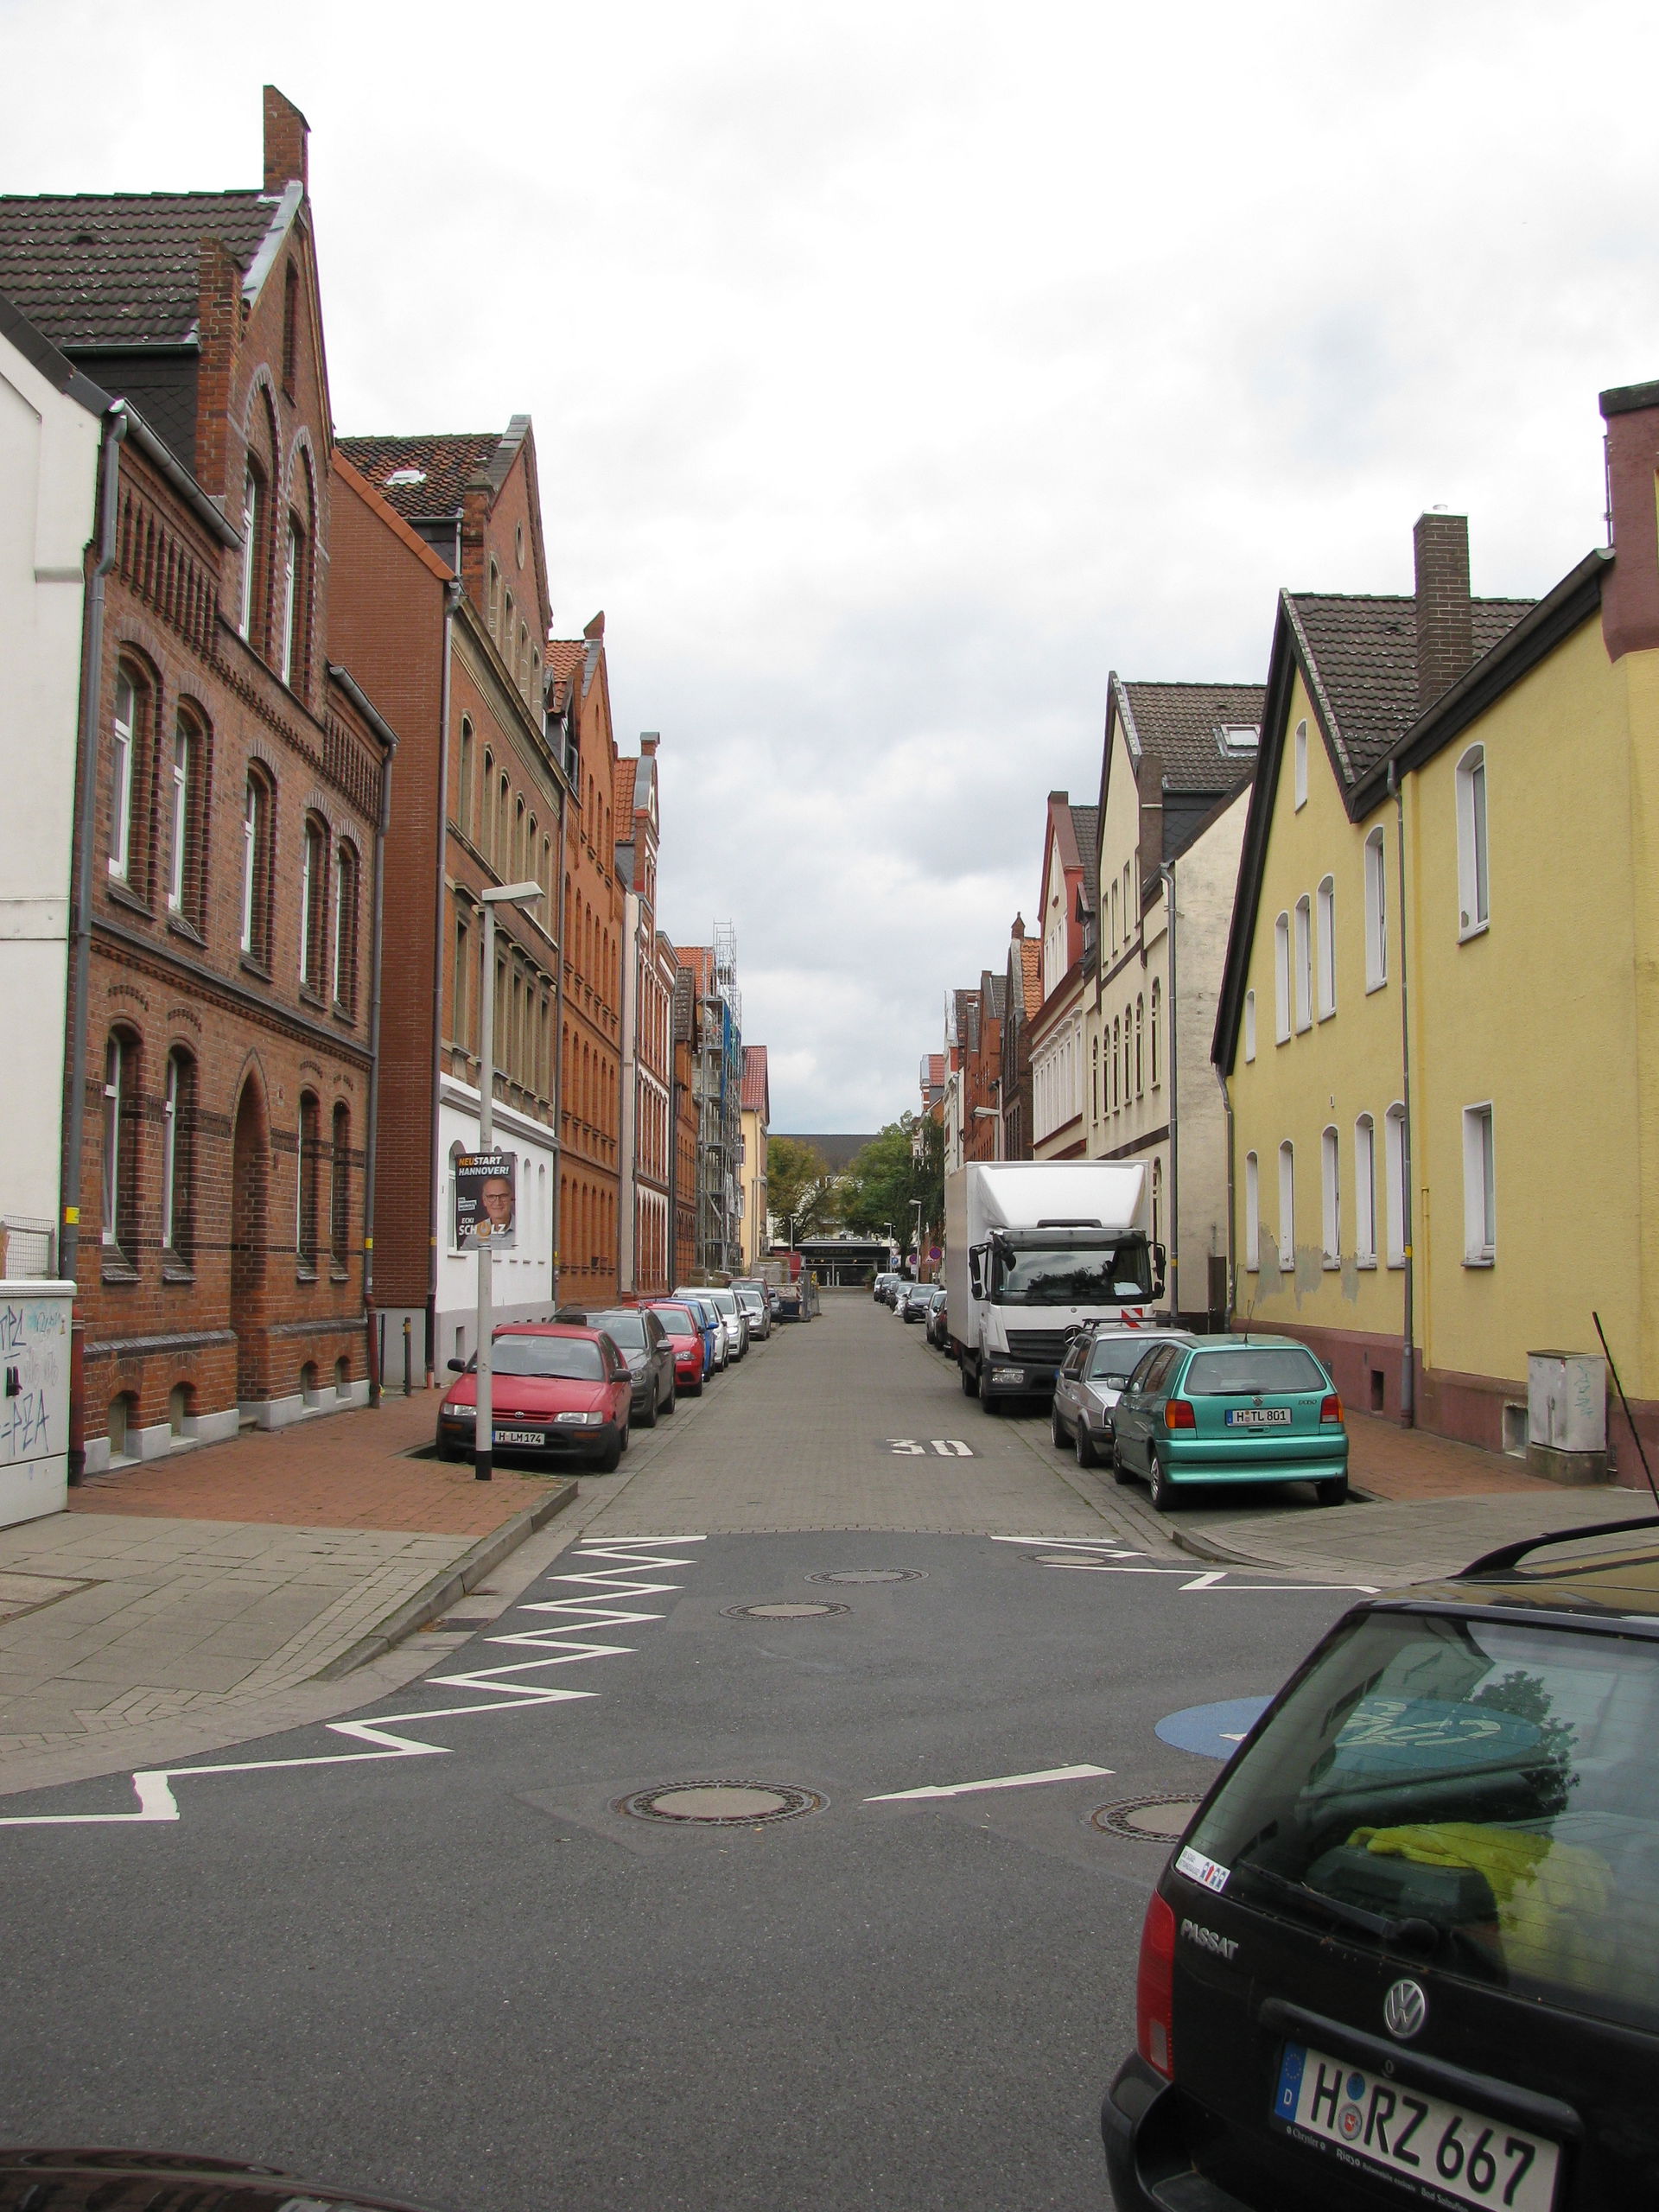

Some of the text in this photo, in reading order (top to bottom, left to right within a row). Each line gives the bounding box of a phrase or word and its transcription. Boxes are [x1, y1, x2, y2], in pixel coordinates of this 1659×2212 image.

[459, 1156, 502, 1166] NEUSTART
[459, 1166, 510, 1176] HANNOVER!
[1236, 1410, 1286, 1422] H TL 801
[511, 1433, 523, 1442] LM
[524, 1434, 541, 1443] 174
[886, 1439, 973, 1456] 30
[1180, 1918, 1239, 1961] PASSAT
[1283, 2088, 1293, 2106] D
[1311, 2063, 1536, 2207] H RZ 667
